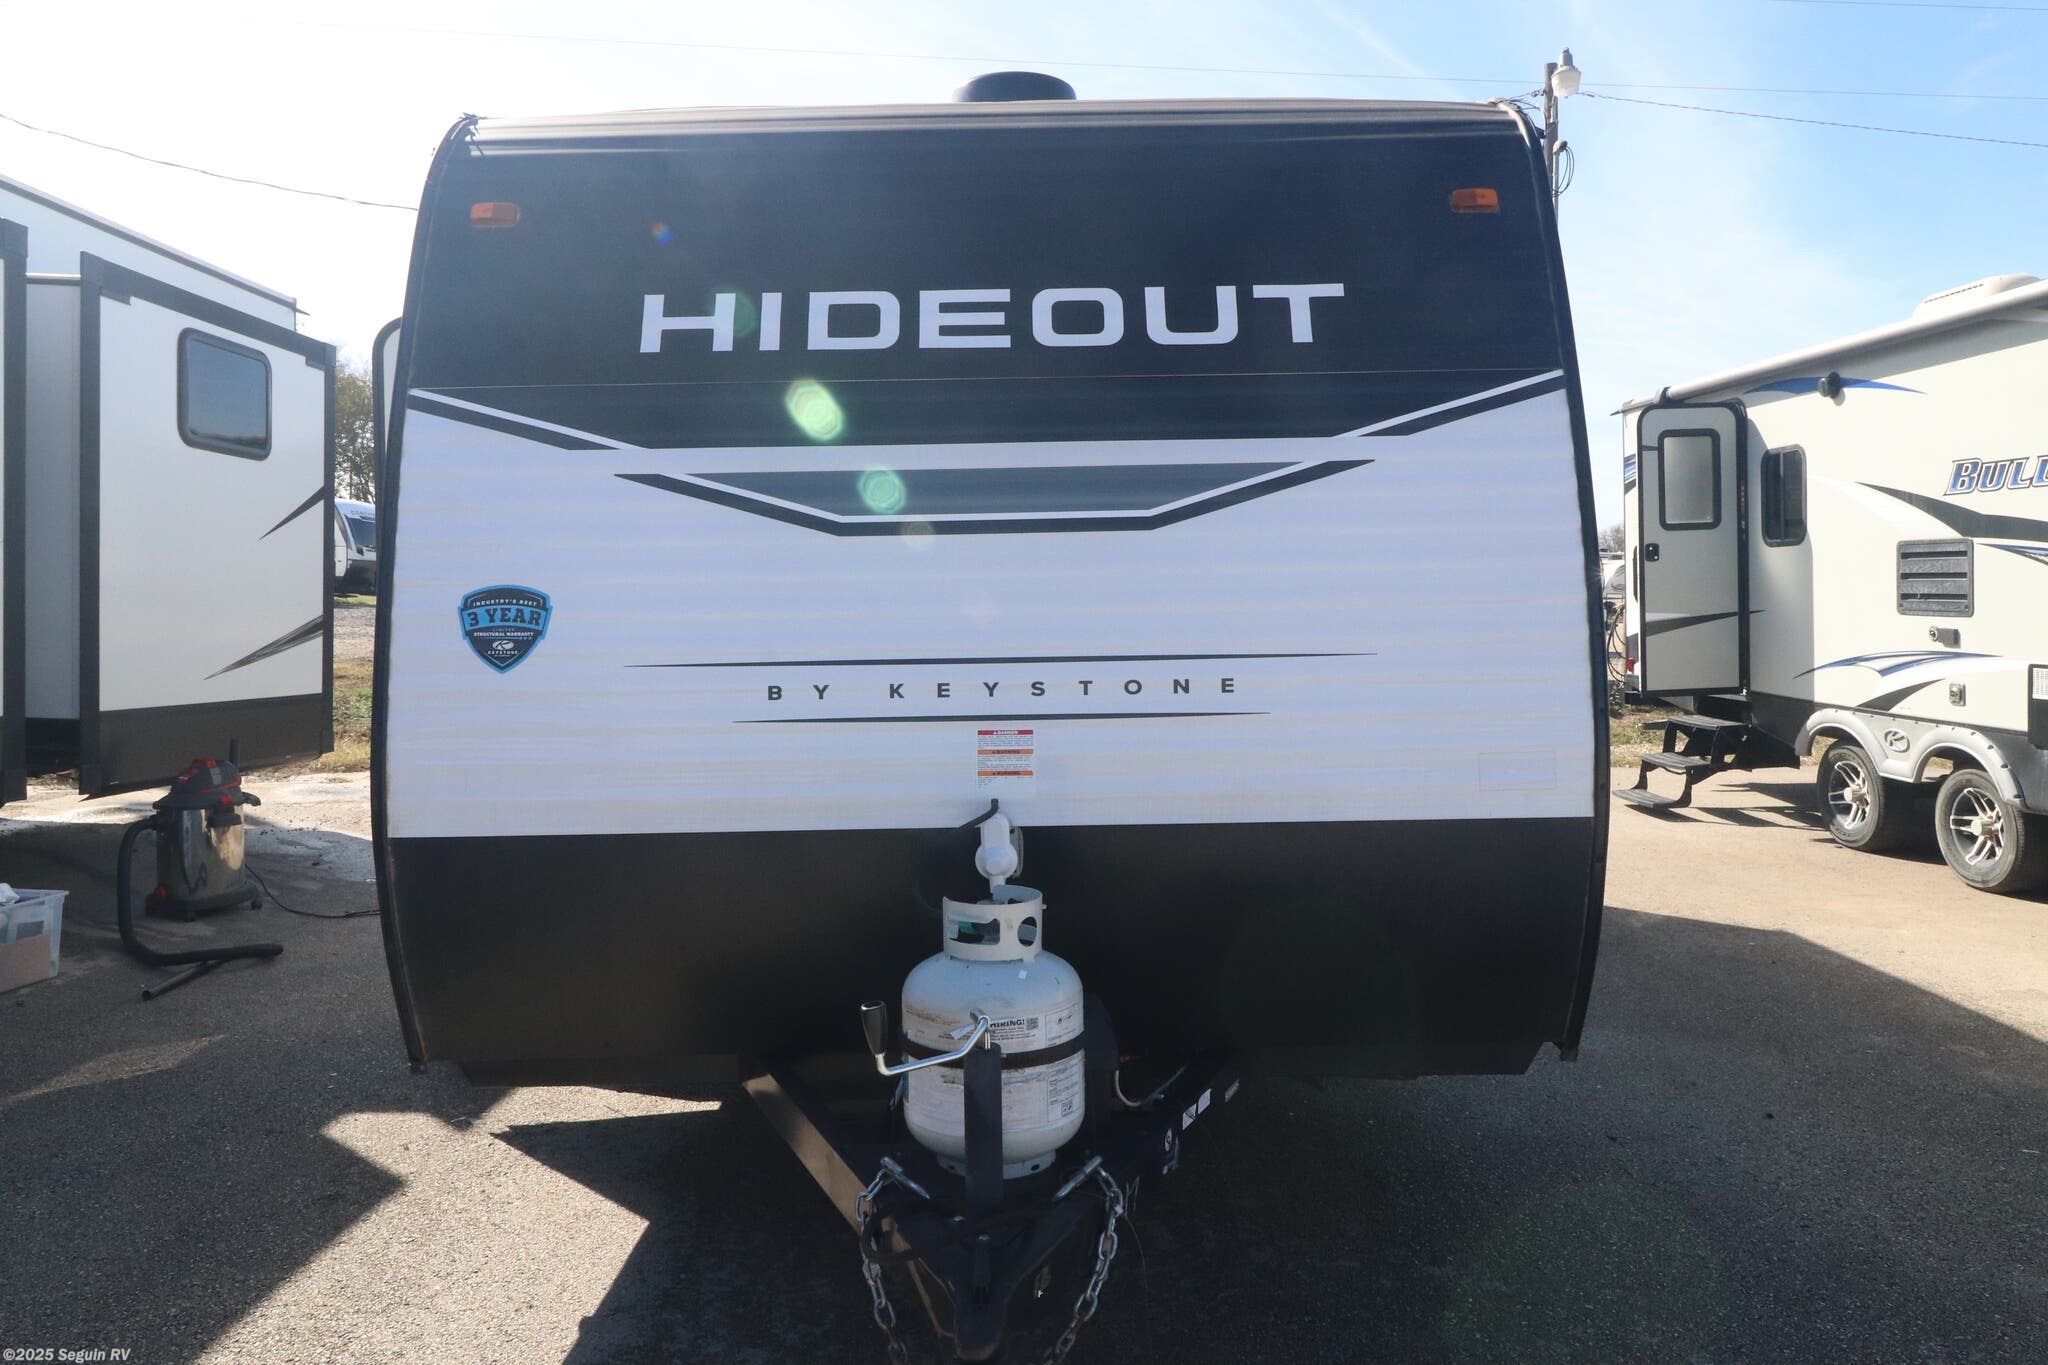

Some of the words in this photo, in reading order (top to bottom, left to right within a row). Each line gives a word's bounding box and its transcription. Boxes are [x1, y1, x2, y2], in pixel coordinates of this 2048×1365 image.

[639, 283, 1345, 353] HIDEOUT
[472, 599, 517, 607] INDUSTRY'S
[467, 611, 480, 627] 3
[484, 607, 542, 626] YEAR
[767, 684, 830, 701] BY
[889, 677, 1235, 699] KEYSTONE
